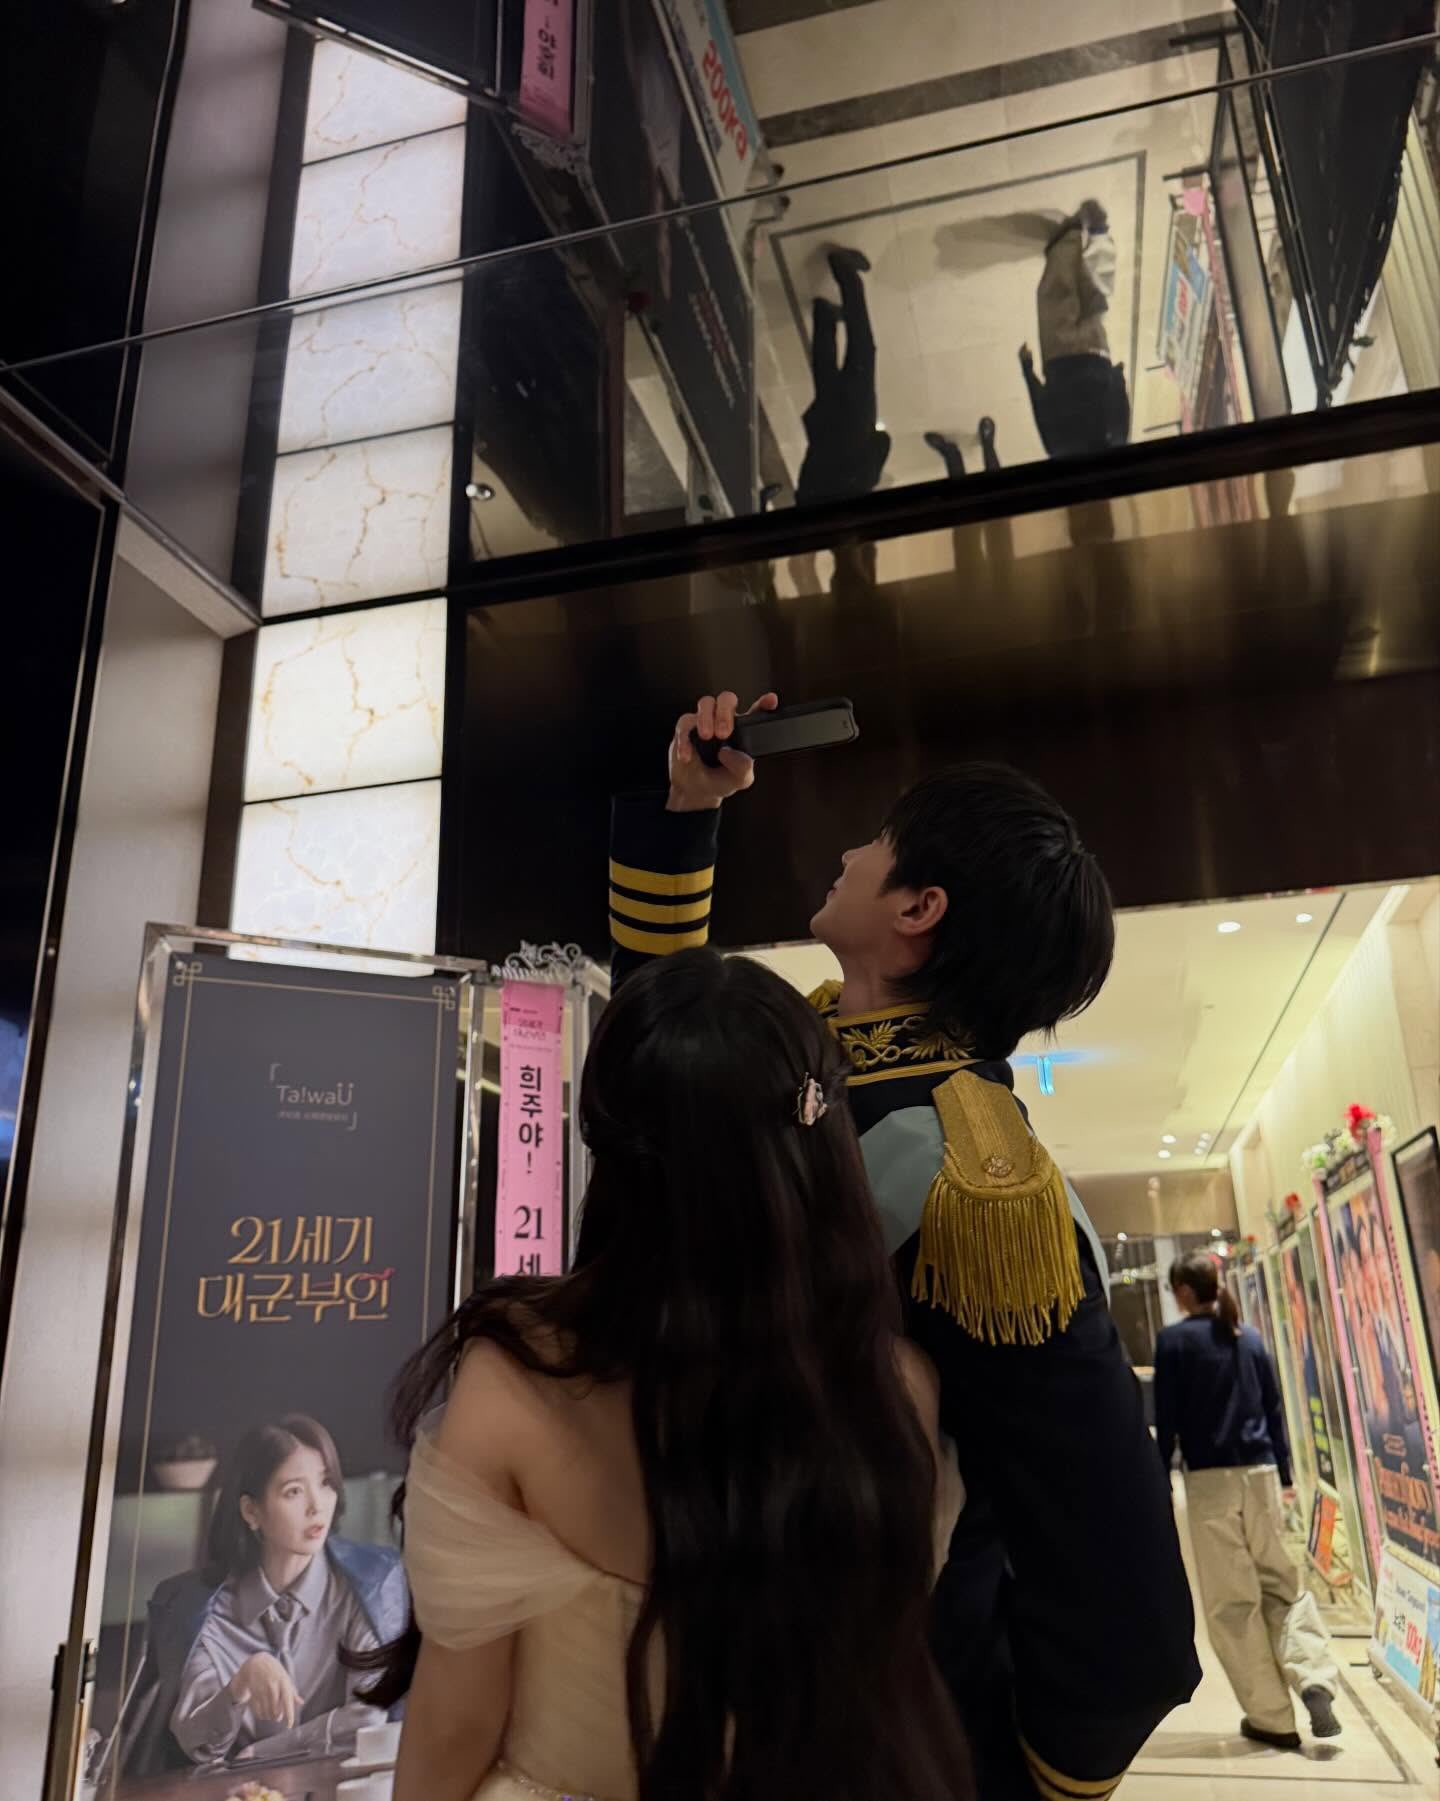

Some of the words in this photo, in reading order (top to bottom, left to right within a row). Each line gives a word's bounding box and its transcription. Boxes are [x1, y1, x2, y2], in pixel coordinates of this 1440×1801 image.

[518, 1064, 544, 1175] 희주야!
[227, 1215, 373, 1265] 21세기
[196, 1268, 392, 1324] 대군부인
